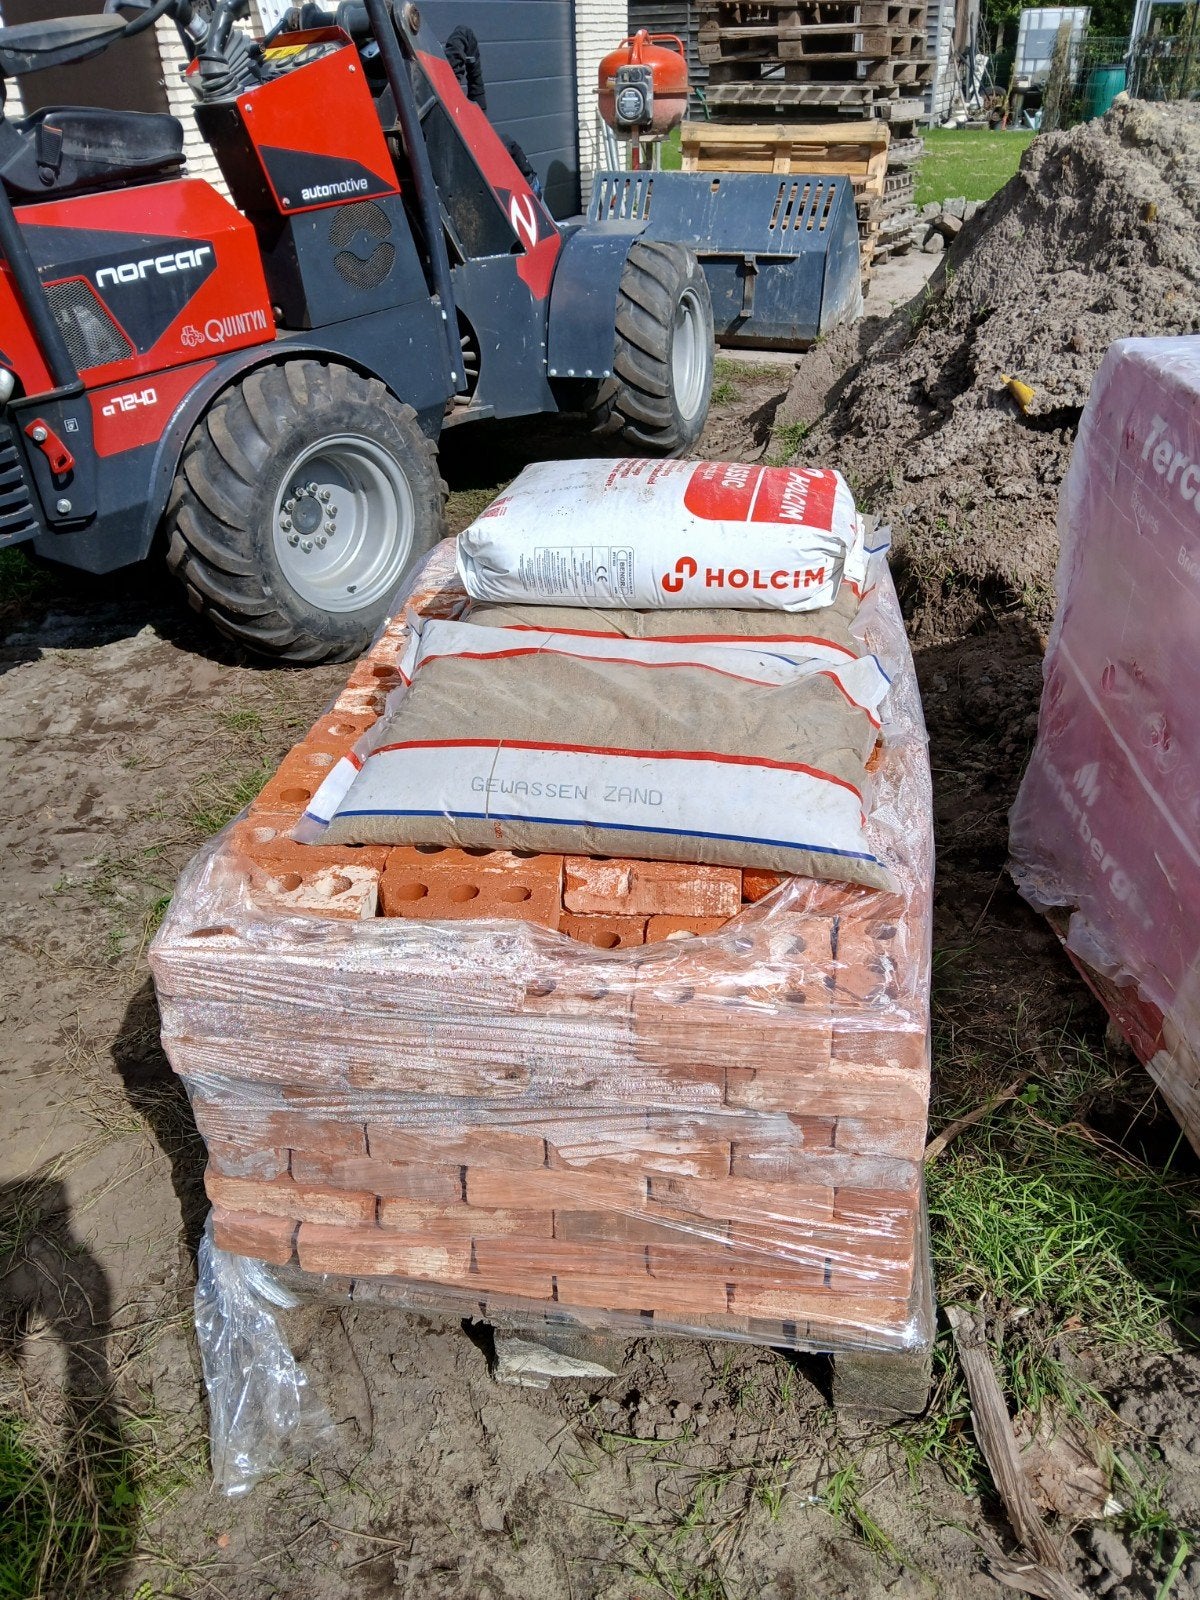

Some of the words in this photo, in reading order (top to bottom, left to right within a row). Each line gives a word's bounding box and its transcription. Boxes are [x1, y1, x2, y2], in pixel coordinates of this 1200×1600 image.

[301, 178, 368, 200] automotive
[95, 246, 211, 288] norcar
[204, 309, 267, 343] QUINTYN
[779, 471, 811, 521] HOLCIM
[706, 566, 825, 589] HOLCIM
[471, 776, 588, 800] GEWASSEN
[603, 785, 663, 806] ZAND
